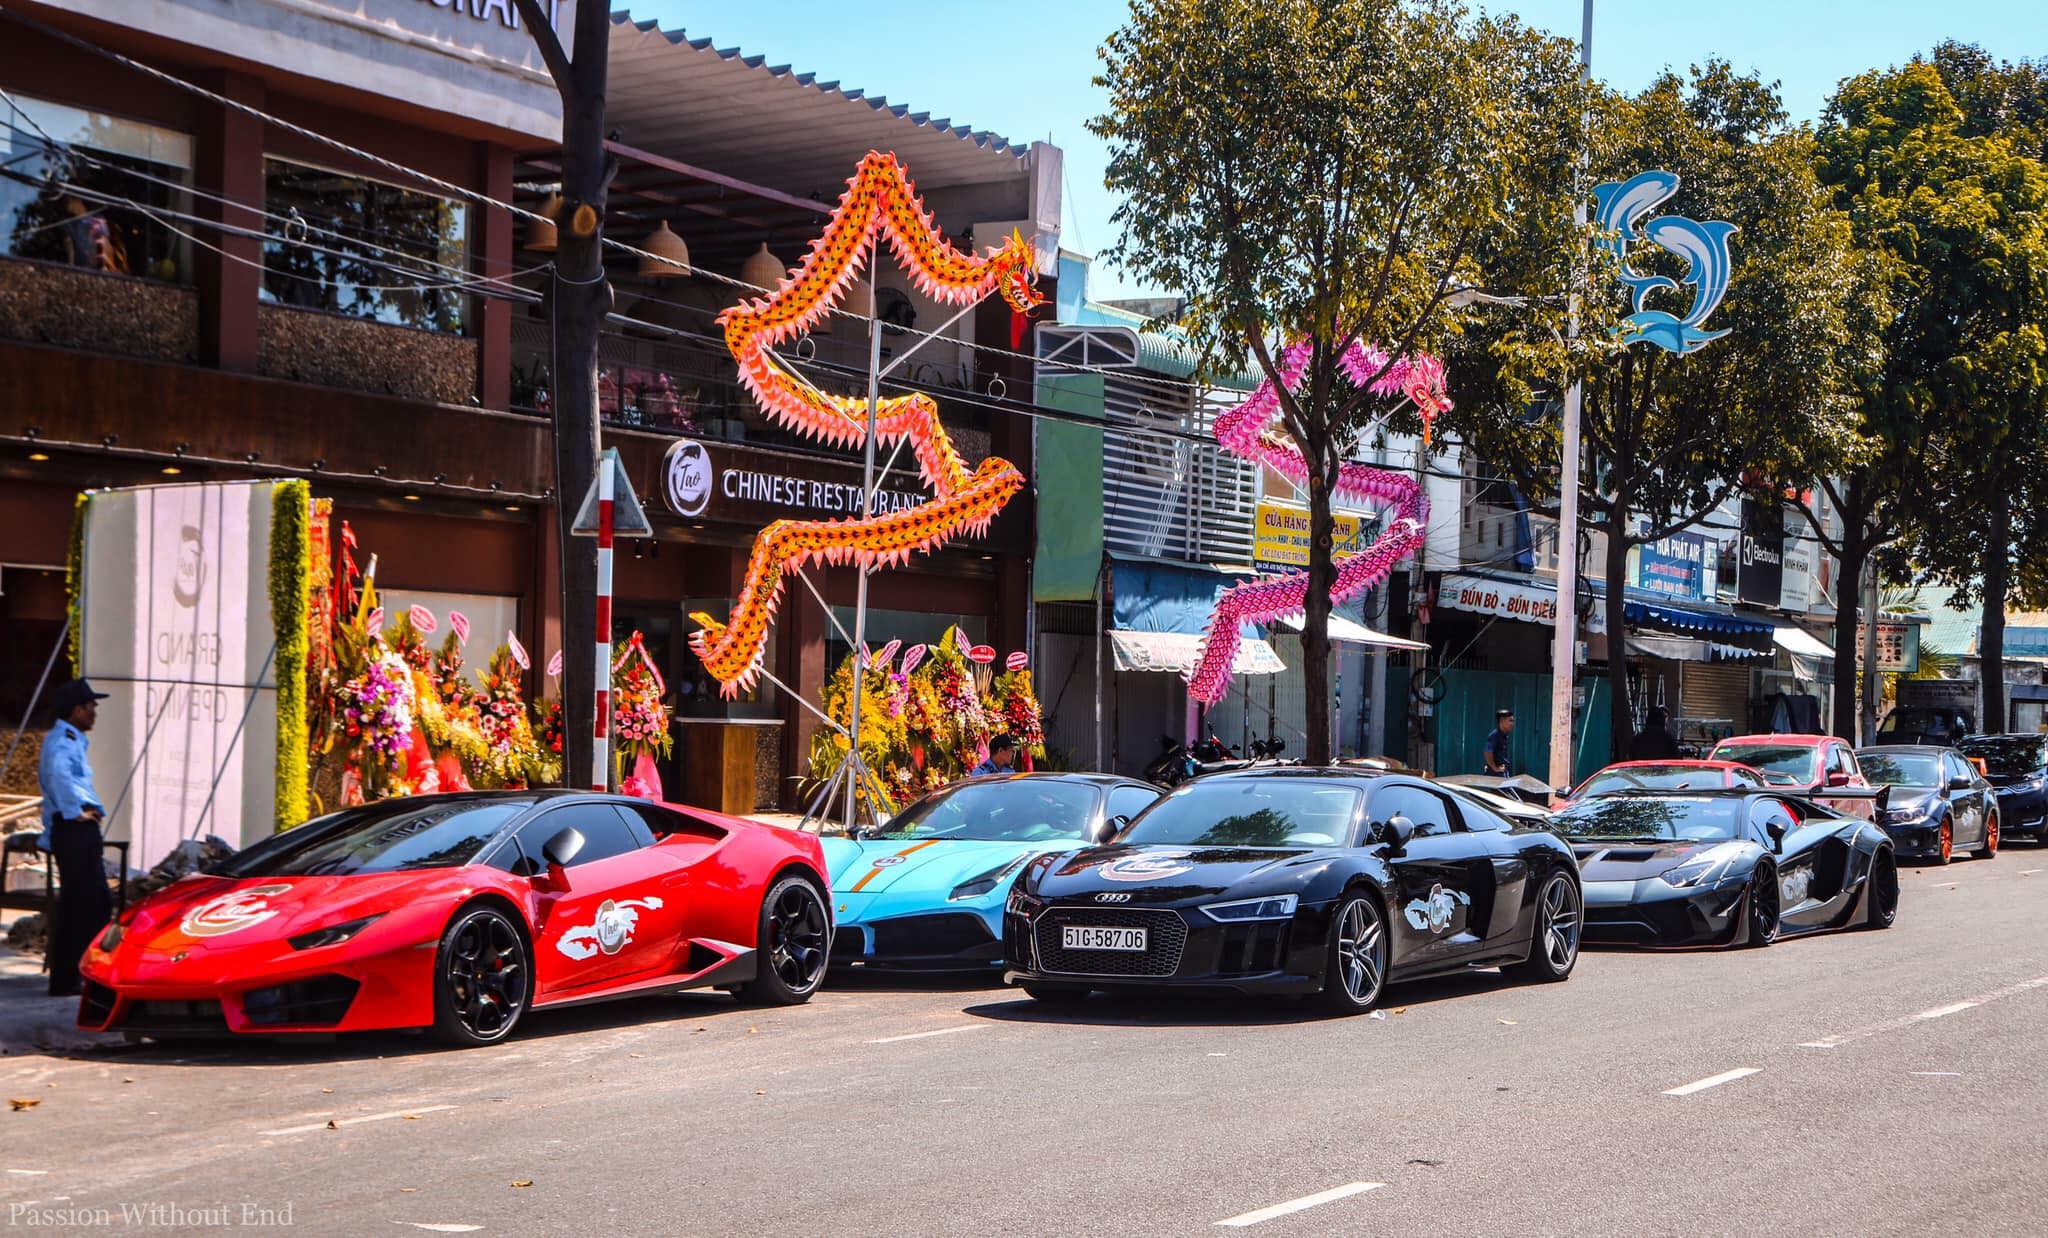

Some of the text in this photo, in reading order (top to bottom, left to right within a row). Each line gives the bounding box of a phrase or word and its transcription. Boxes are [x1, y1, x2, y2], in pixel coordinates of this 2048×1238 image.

[680, 464, 702, 490] Tao
[723, 470, 806, 507] CHINESE
[1754, 545, 1780, 564] Electrolux
[1460, 587, 1481, 606] BÚN
[1484, 590, 1498, 609] BÒ
[1507, 595, 1531, 614] BÚN
[602, 917, 619, 939] Tao
[1065, 929, 1143, 948] 51G-587.06
